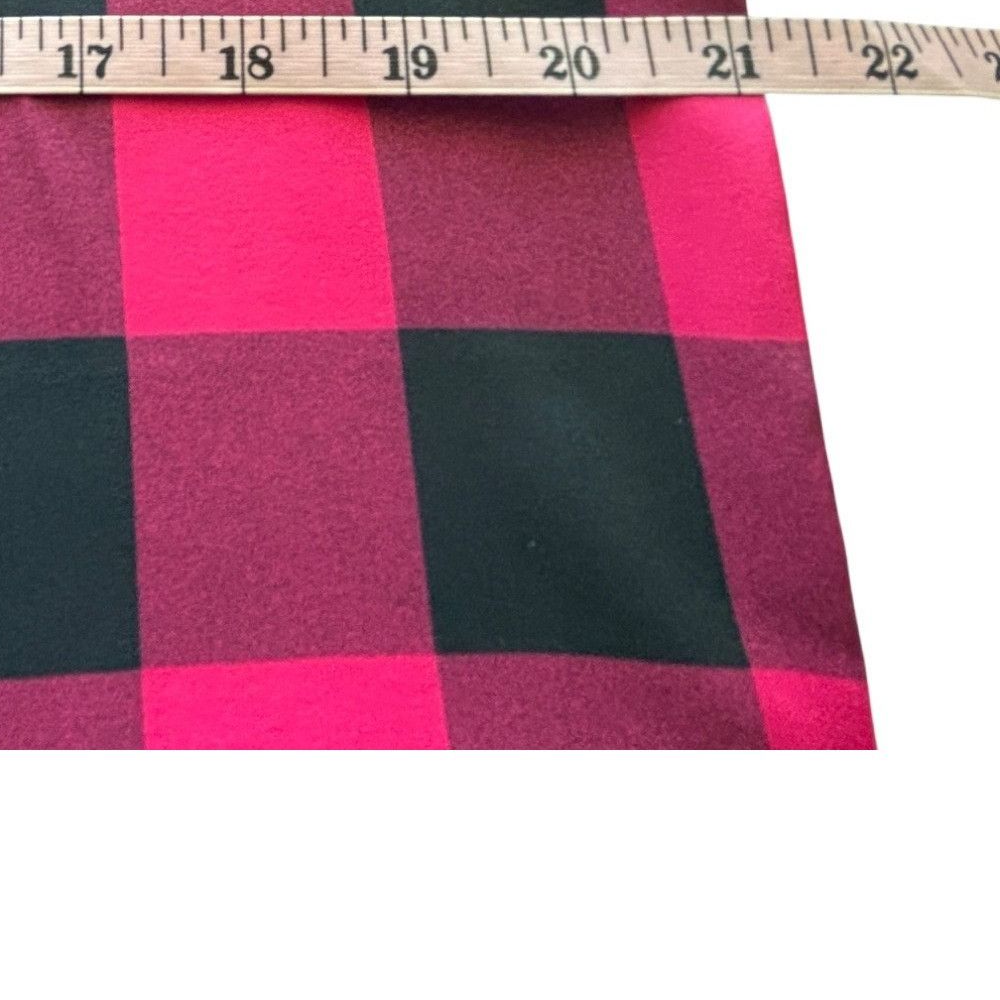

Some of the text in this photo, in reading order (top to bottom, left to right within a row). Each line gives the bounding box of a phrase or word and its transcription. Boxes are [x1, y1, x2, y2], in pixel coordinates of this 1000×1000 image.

[57, 44, 113, 79] 17
[219, 45, 274, 80] 18
[382, 45, 438, 81] 19
[539, 46, 600, 80] 20
[702, 44, 760, 80] 21
[861, 44, 918, 80] 22
